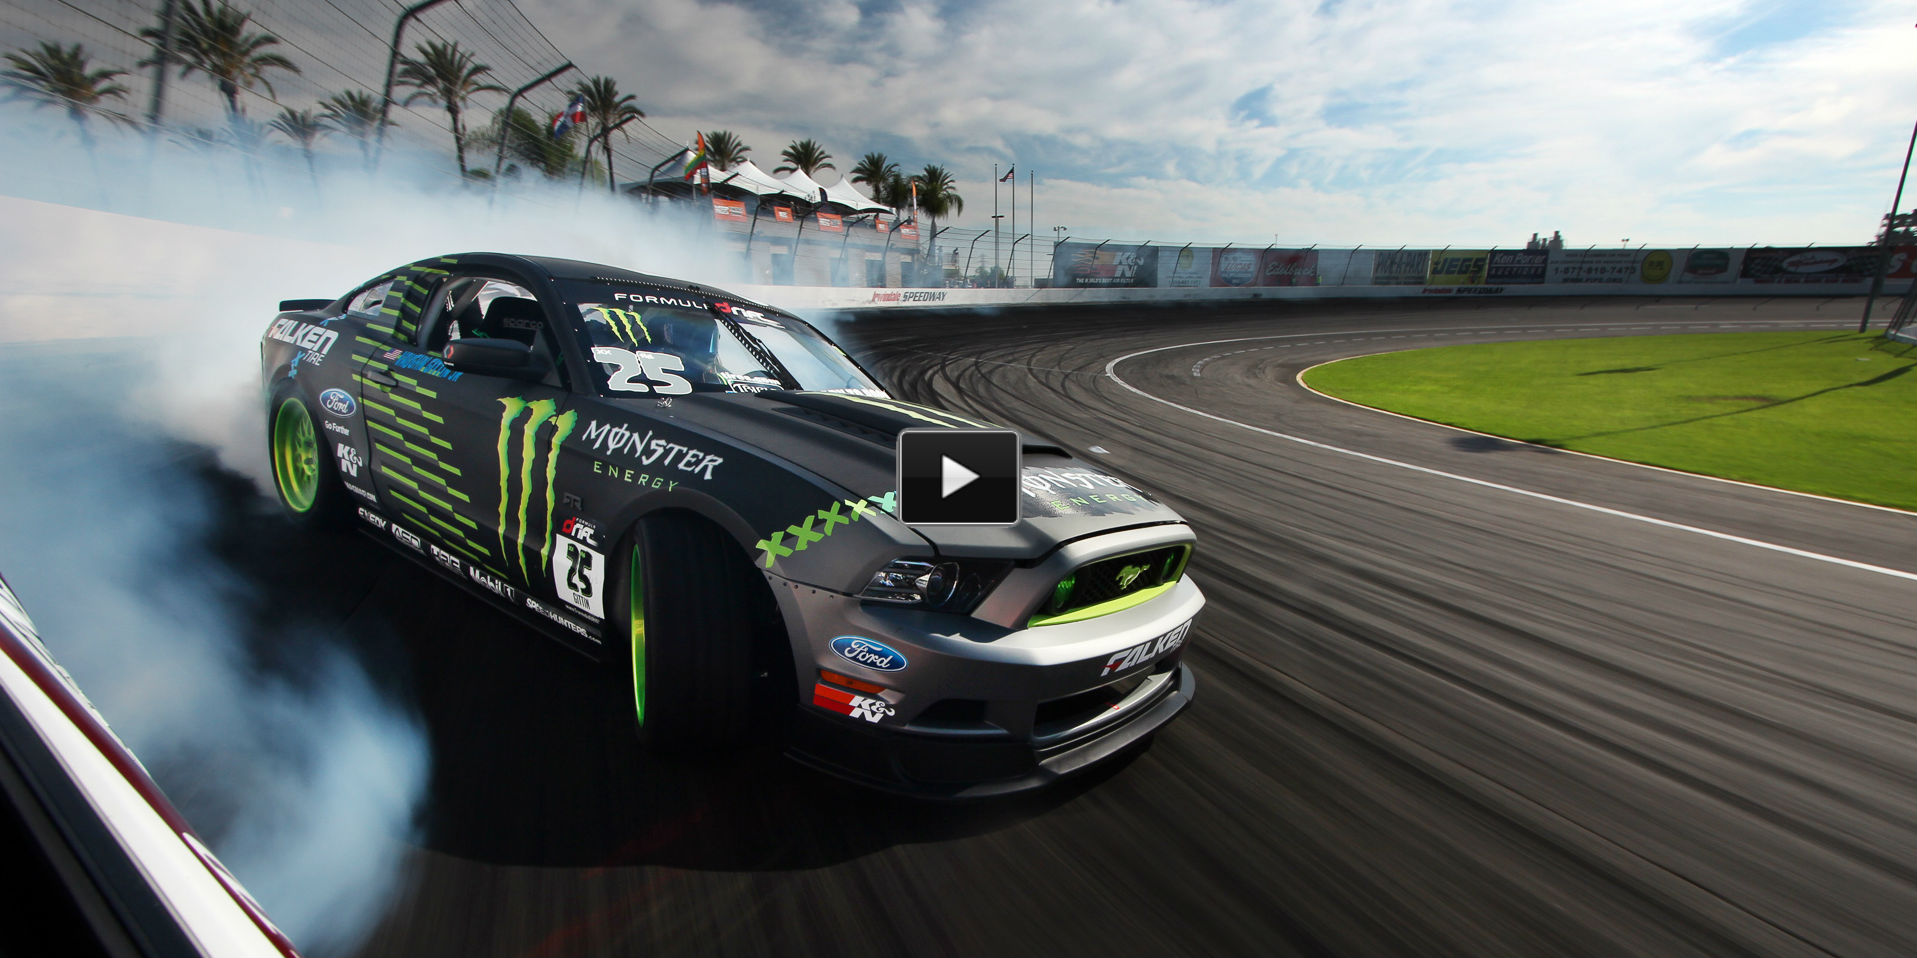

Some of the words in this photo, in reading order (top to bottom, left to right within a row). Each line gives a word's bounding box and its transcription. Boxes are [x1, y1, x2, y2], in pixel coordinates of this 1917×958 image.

[1432, 257, 1486, 276] JEGS
[903, 291, 947, 302] SPEEDWAY
[269, 319, 338, 354] FALKEN
[303, 350, 326, 366] TIRE
[590, 347, 692, 395] 25
[326, 391, 349, 414] Ford
[593, 461, 679, 493] ENERGY
[1050, 493, 1150, 511] ENERGY
[469, 566, 503, 597] Mobil
[566, 543, 593, 598] 25
[844, 640, 894, 669] Ford
[1100, 618, 1193, 677] FALKEN
